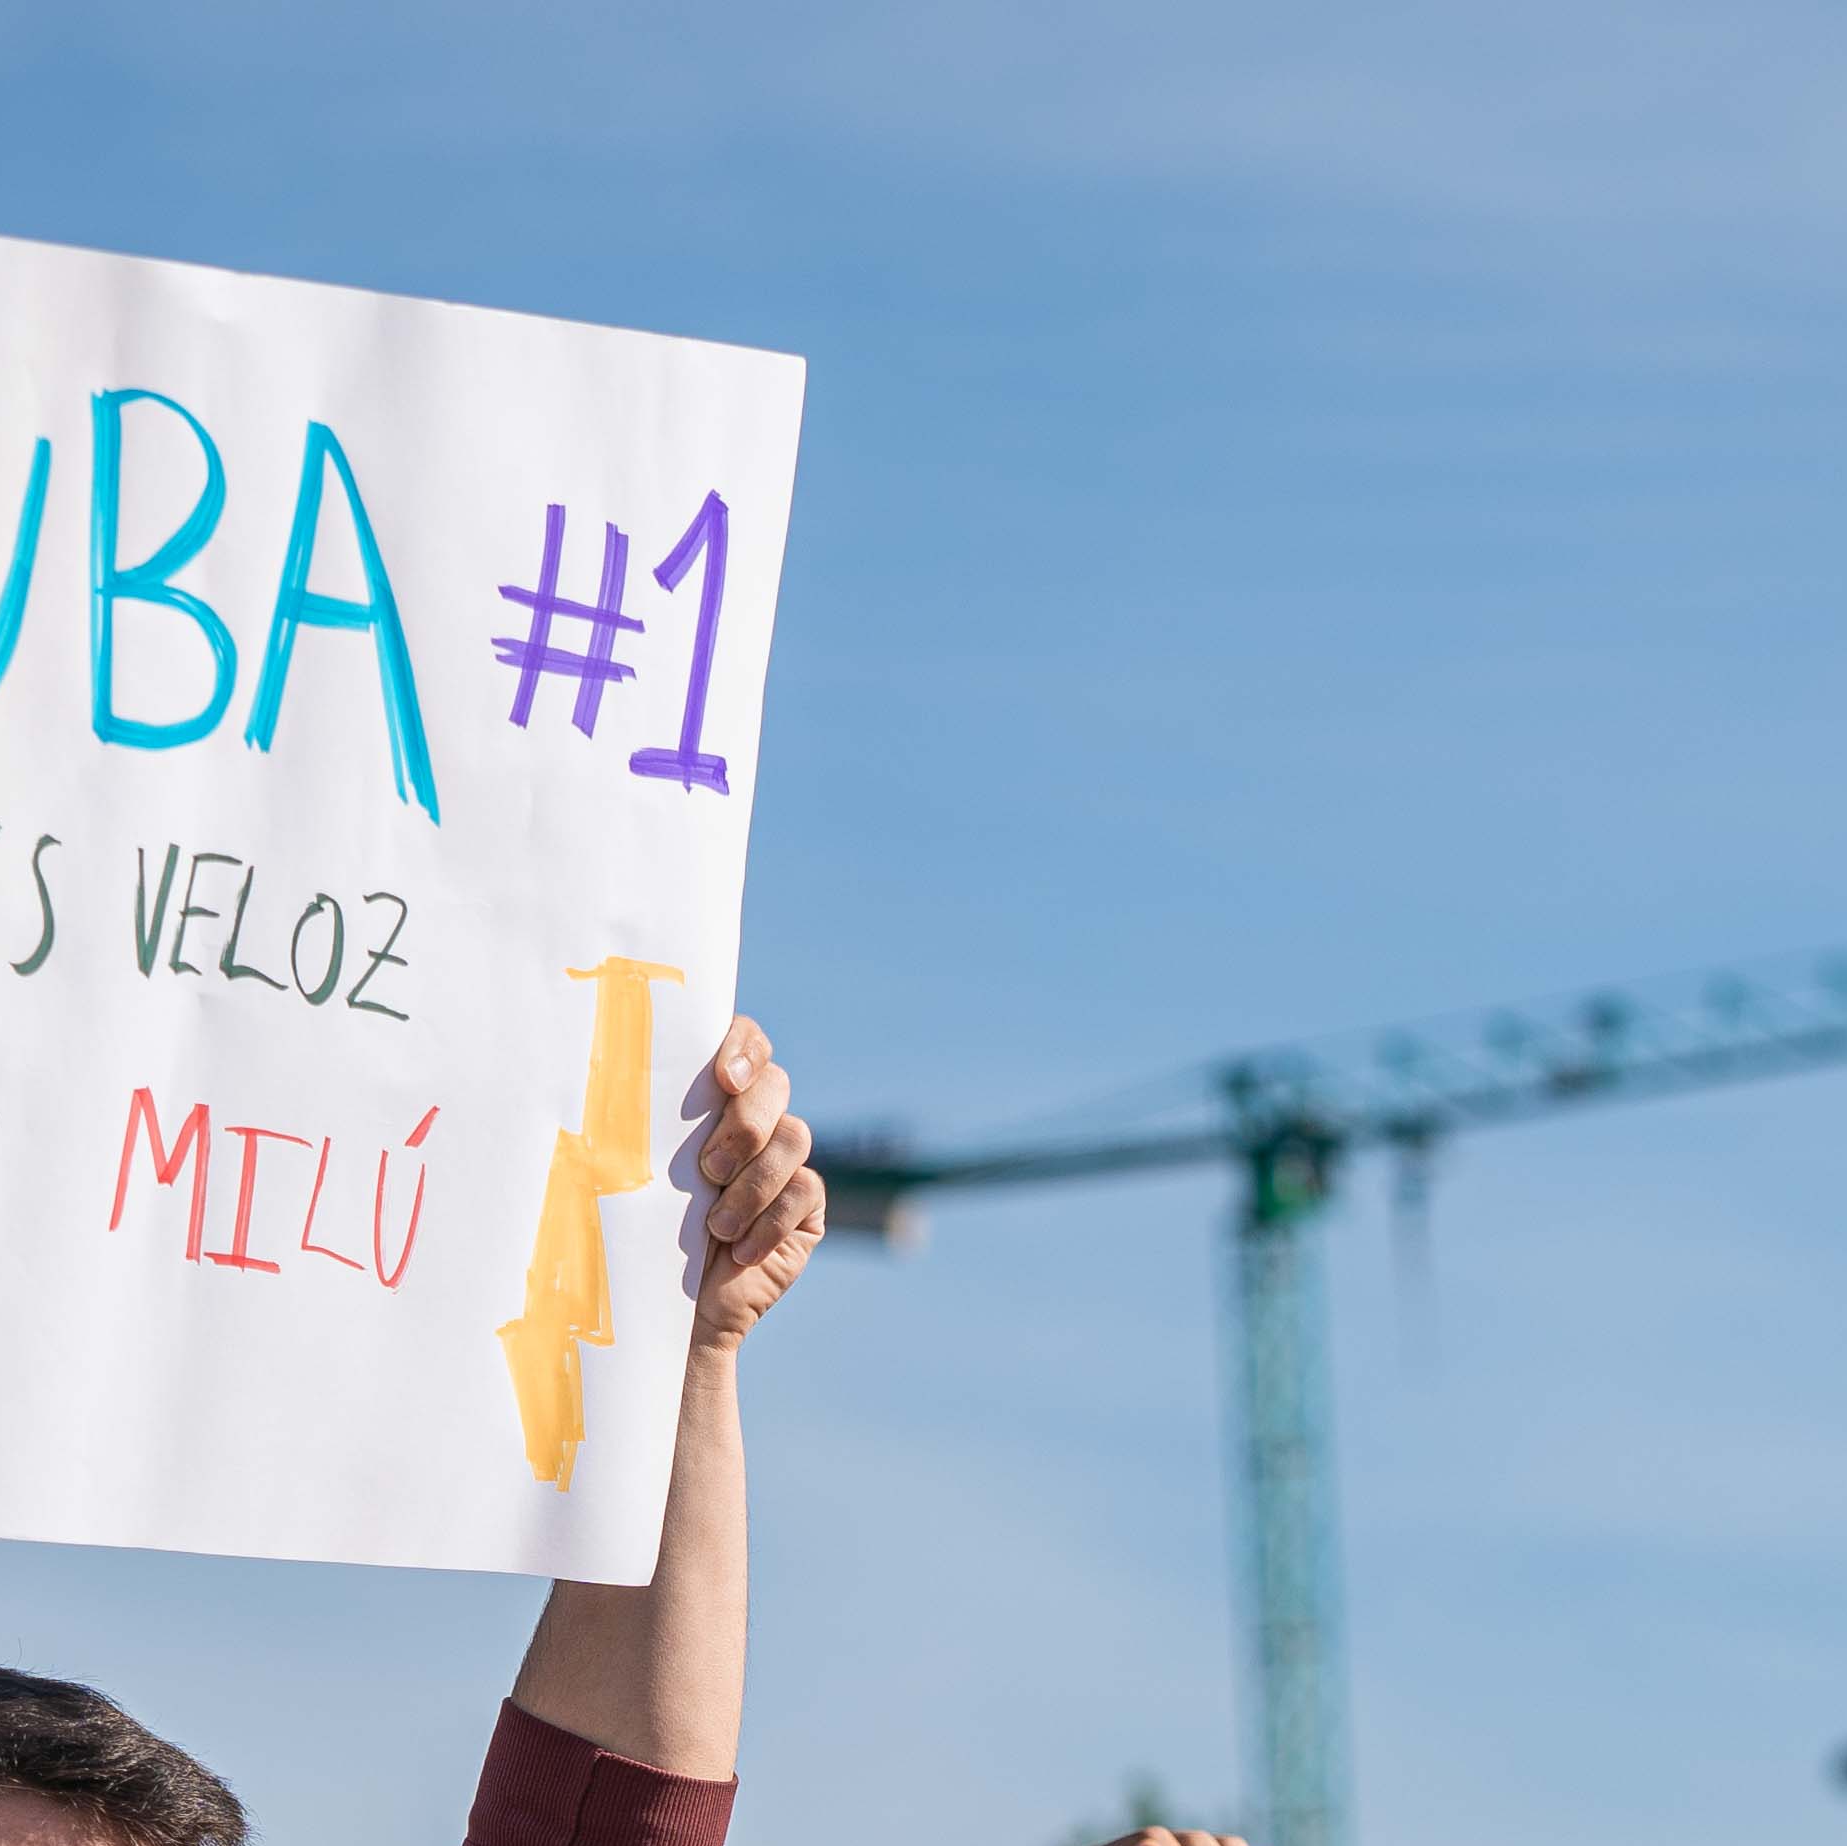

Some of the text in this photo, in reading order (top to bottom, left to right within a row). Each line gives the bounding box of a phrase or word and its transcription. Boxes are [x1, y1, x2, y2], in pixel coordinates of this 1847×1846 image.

[492, 490, 729, 794] #1
[136, 845, 408, 1020] VELOZ
[109, 1088, 439, 1291] MILÚ
